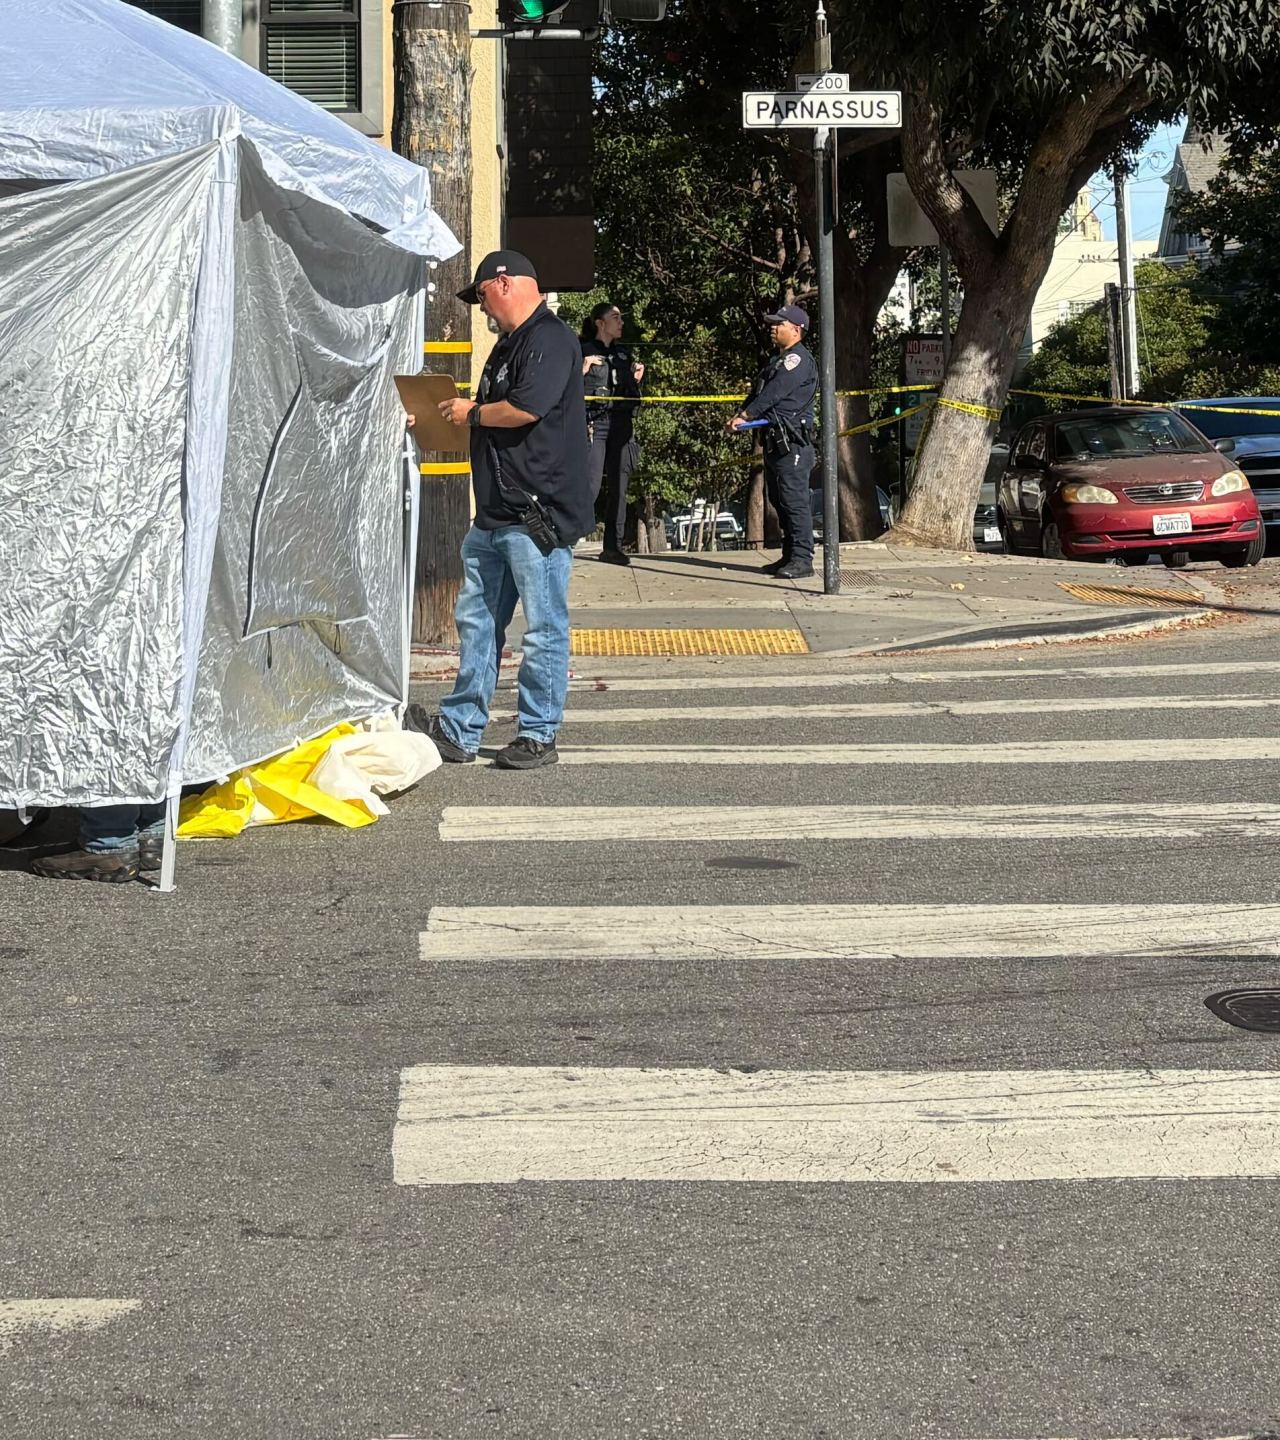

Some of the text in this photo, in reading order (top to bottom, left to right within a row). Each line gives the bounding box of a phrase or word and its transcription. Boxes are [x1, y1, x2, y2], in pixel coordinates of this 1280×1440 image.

[815, 77, 843, 90] 200
[756, 100, 889, 119] PARNASSUS
[907, 340, 919, 353] NO
